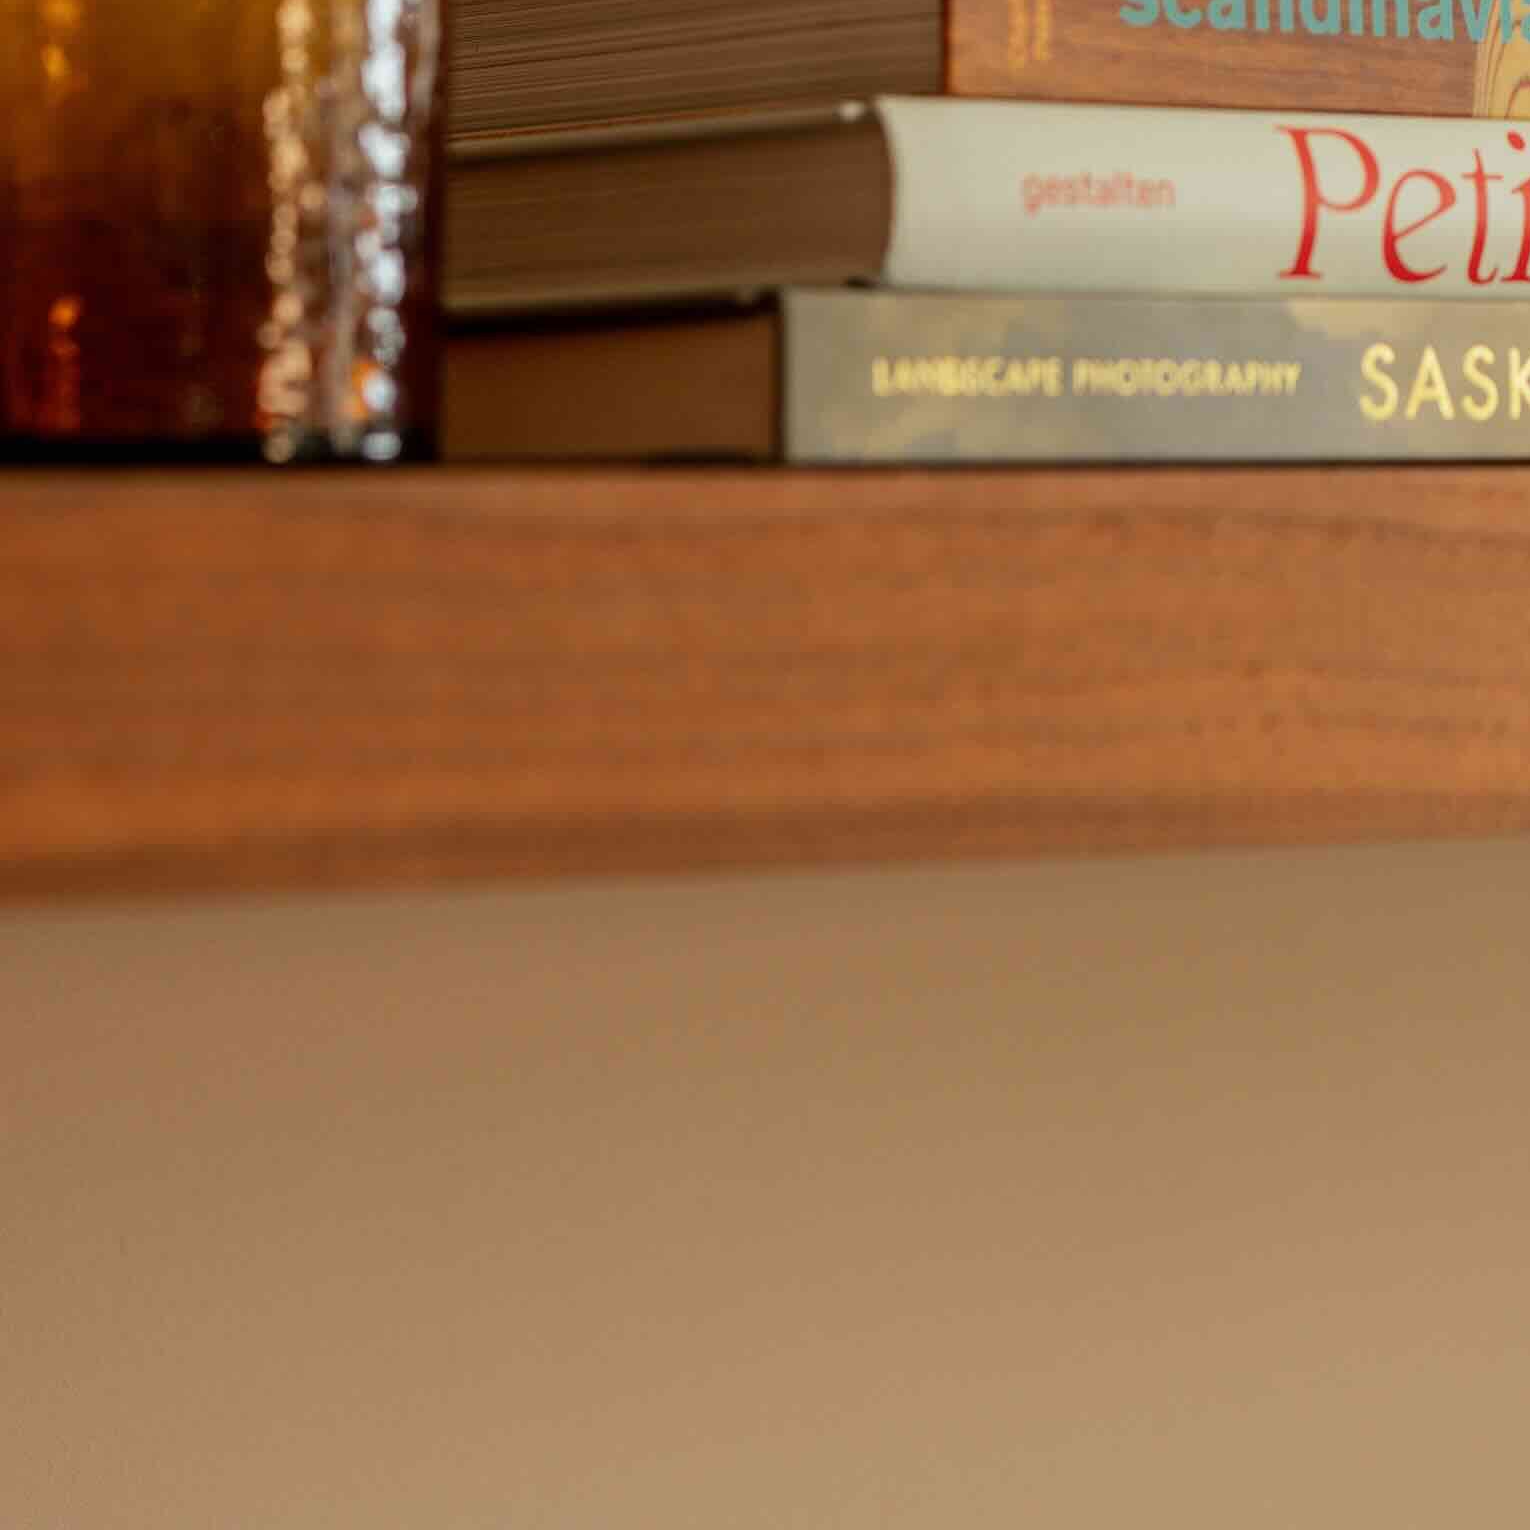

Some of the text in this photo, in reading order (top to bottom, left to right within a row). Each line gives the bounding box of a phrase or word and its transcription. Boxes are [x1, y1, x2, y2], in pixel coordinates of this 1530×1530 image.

[1021, 172, 1175, 215] gestalten
[871, 356, 1301, 396] LANDSCAPE PHOTOGRAPHY
